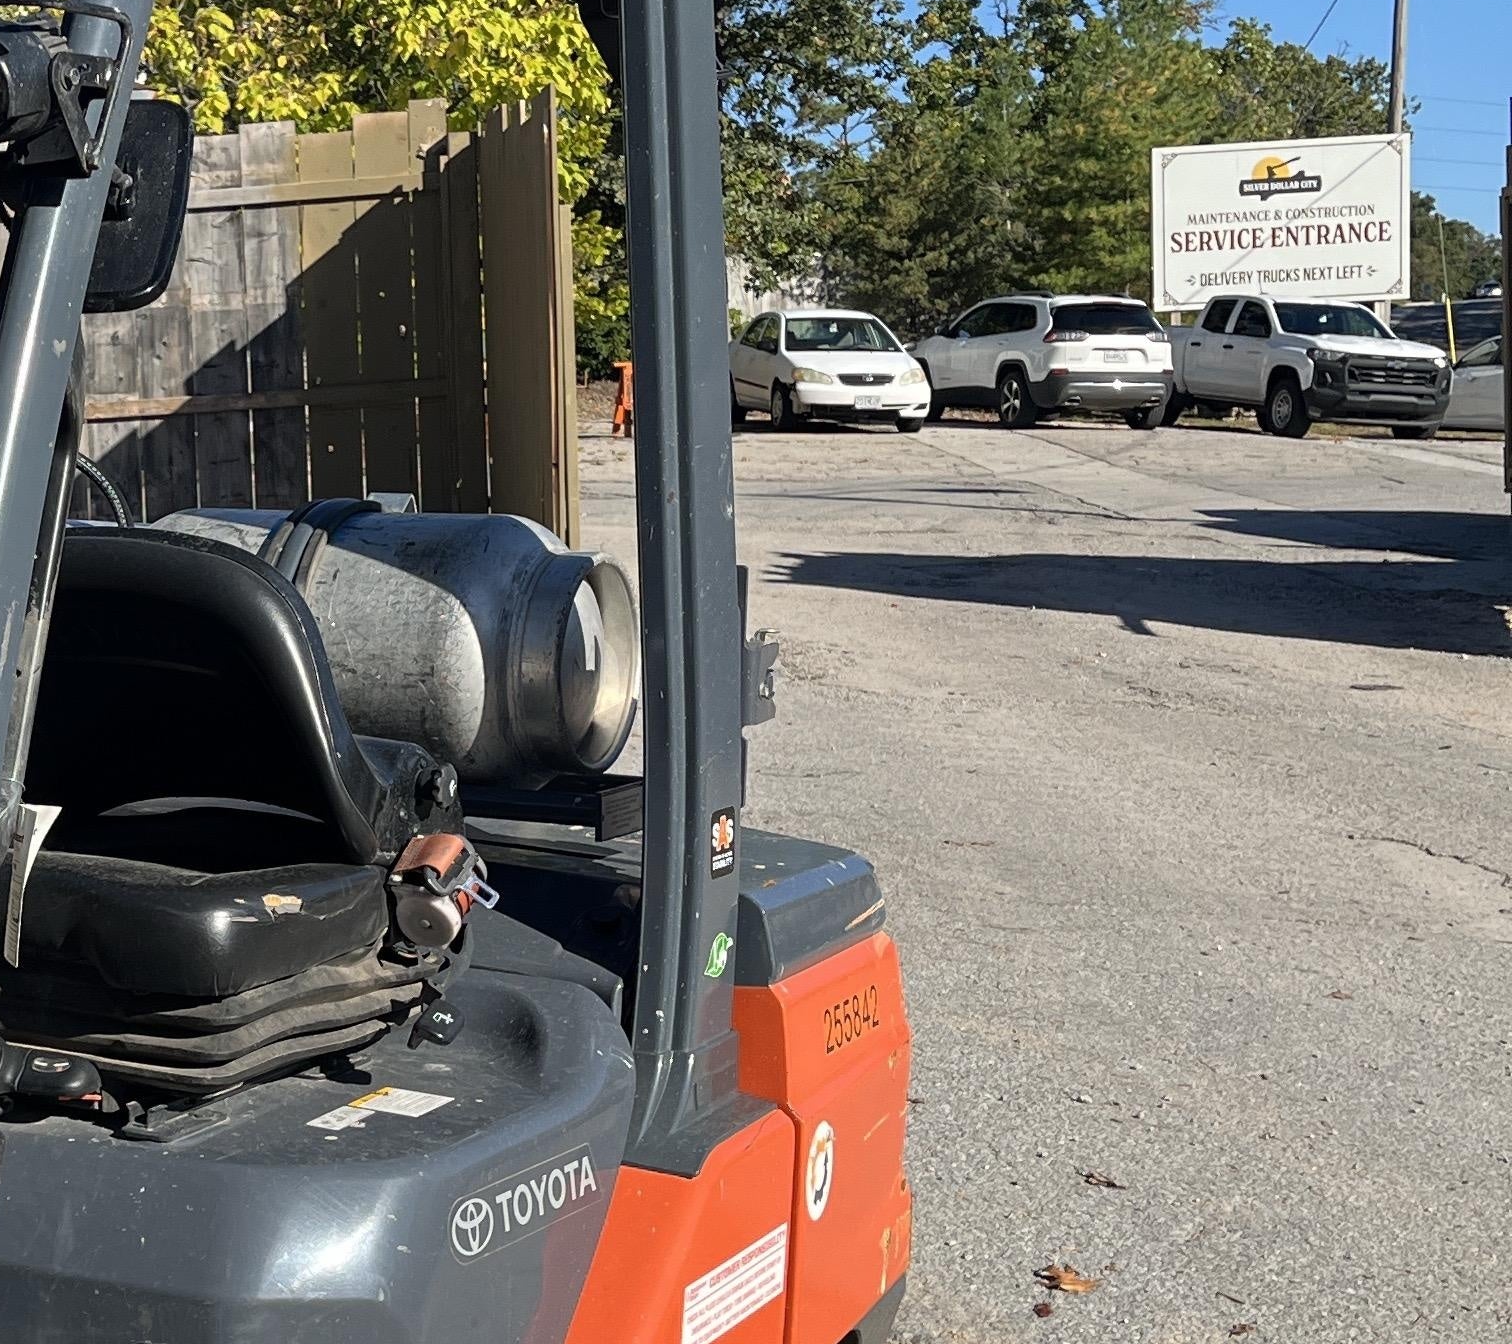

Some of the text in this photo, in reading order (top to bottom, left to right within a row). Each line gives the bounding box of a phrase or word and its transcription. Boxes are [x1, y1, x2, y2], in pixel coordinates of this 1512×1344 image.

[1243, 179, 1318, 193] SILVER DOLLAR CITY
[1187, 204, 1375, 225] MAINTENANCE & CONSTRUCTION
[1170, 220, 1392, 253] SERVICE ENTRANCE
[1200, 264, 1363, 287] DELIVERY TRUCKS NEXT LEFT
[712, 814, 734, 851] SAS
[823, 984, 880, 1055] 255842
[495, 1155, 597, 1233] TOYOTA
